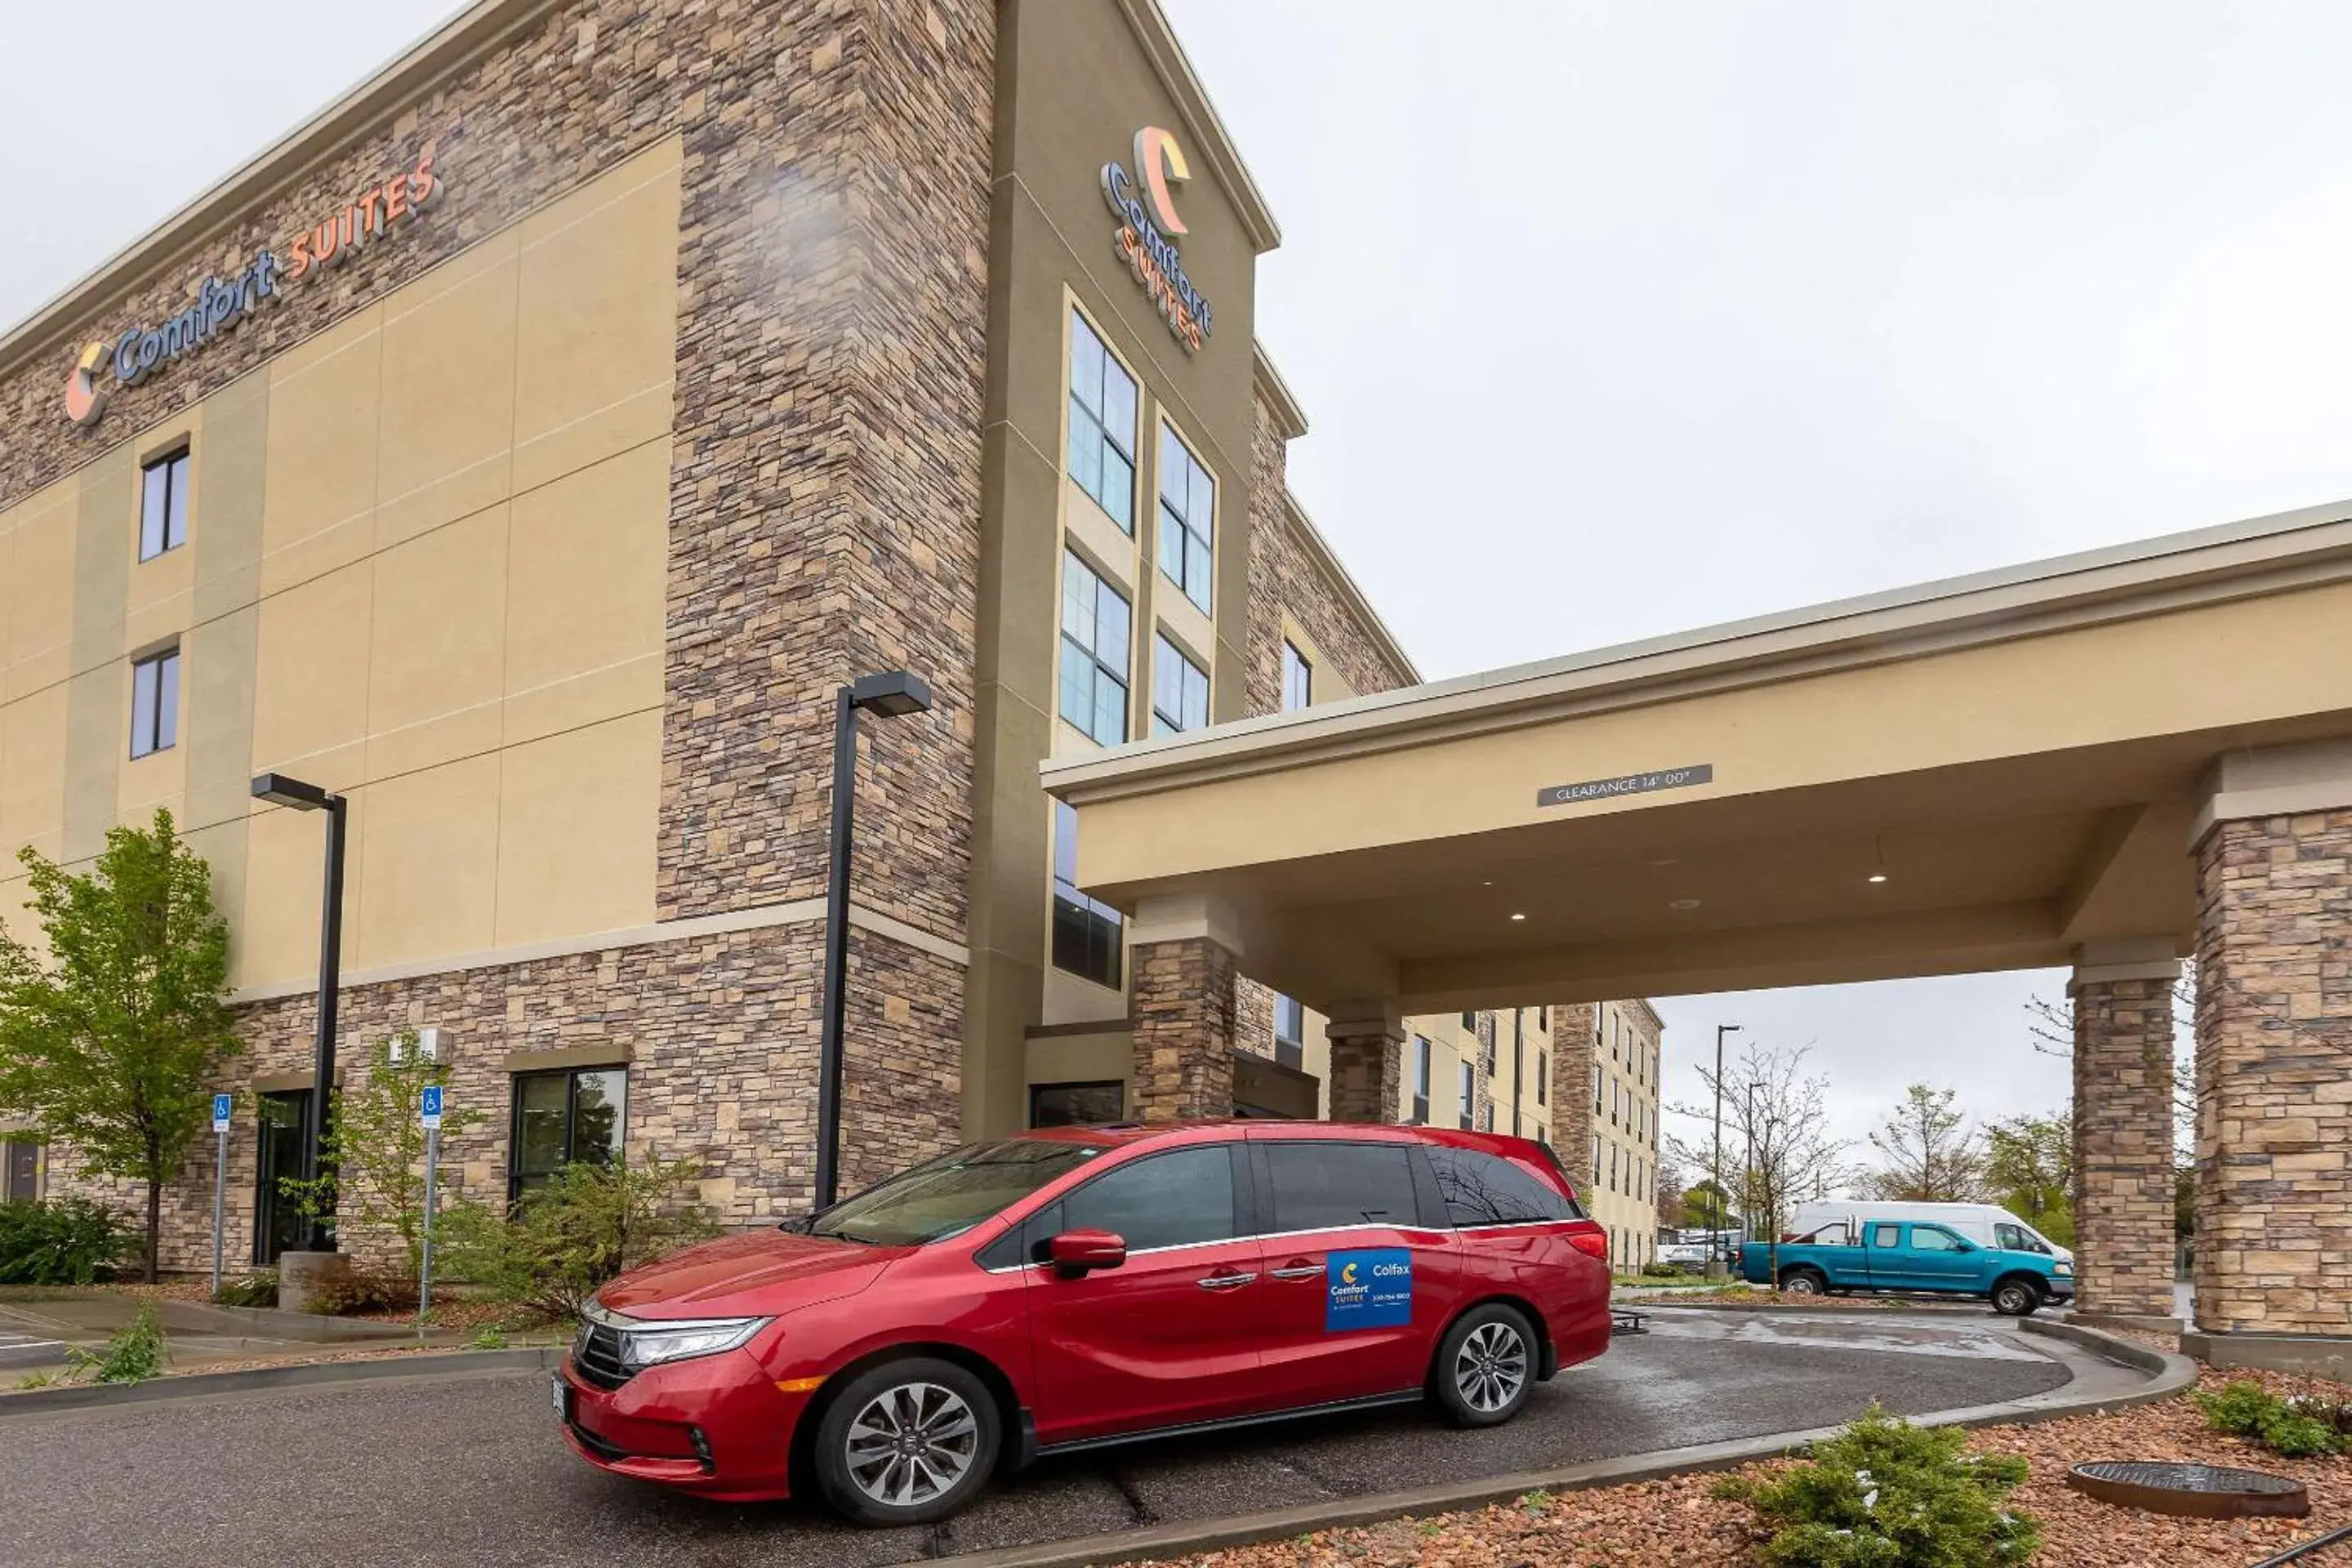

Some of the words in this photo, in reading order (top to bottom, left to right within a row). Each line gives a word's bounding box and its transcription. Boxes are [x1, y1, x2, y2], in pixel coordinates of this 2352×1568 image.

[113, 249, 274, 382] Comfort
[290, 157, 436, 278] SUITES
[1107, 162, 1213, 337] Comfort
[1121, 225, 1200, 352] SUITES
[1556, 778, 1637, 800] CLEARANCE
[1330, 1283, 1369, 1296] Comfort
[1373, 1263, 1410, 1276] Colfax
